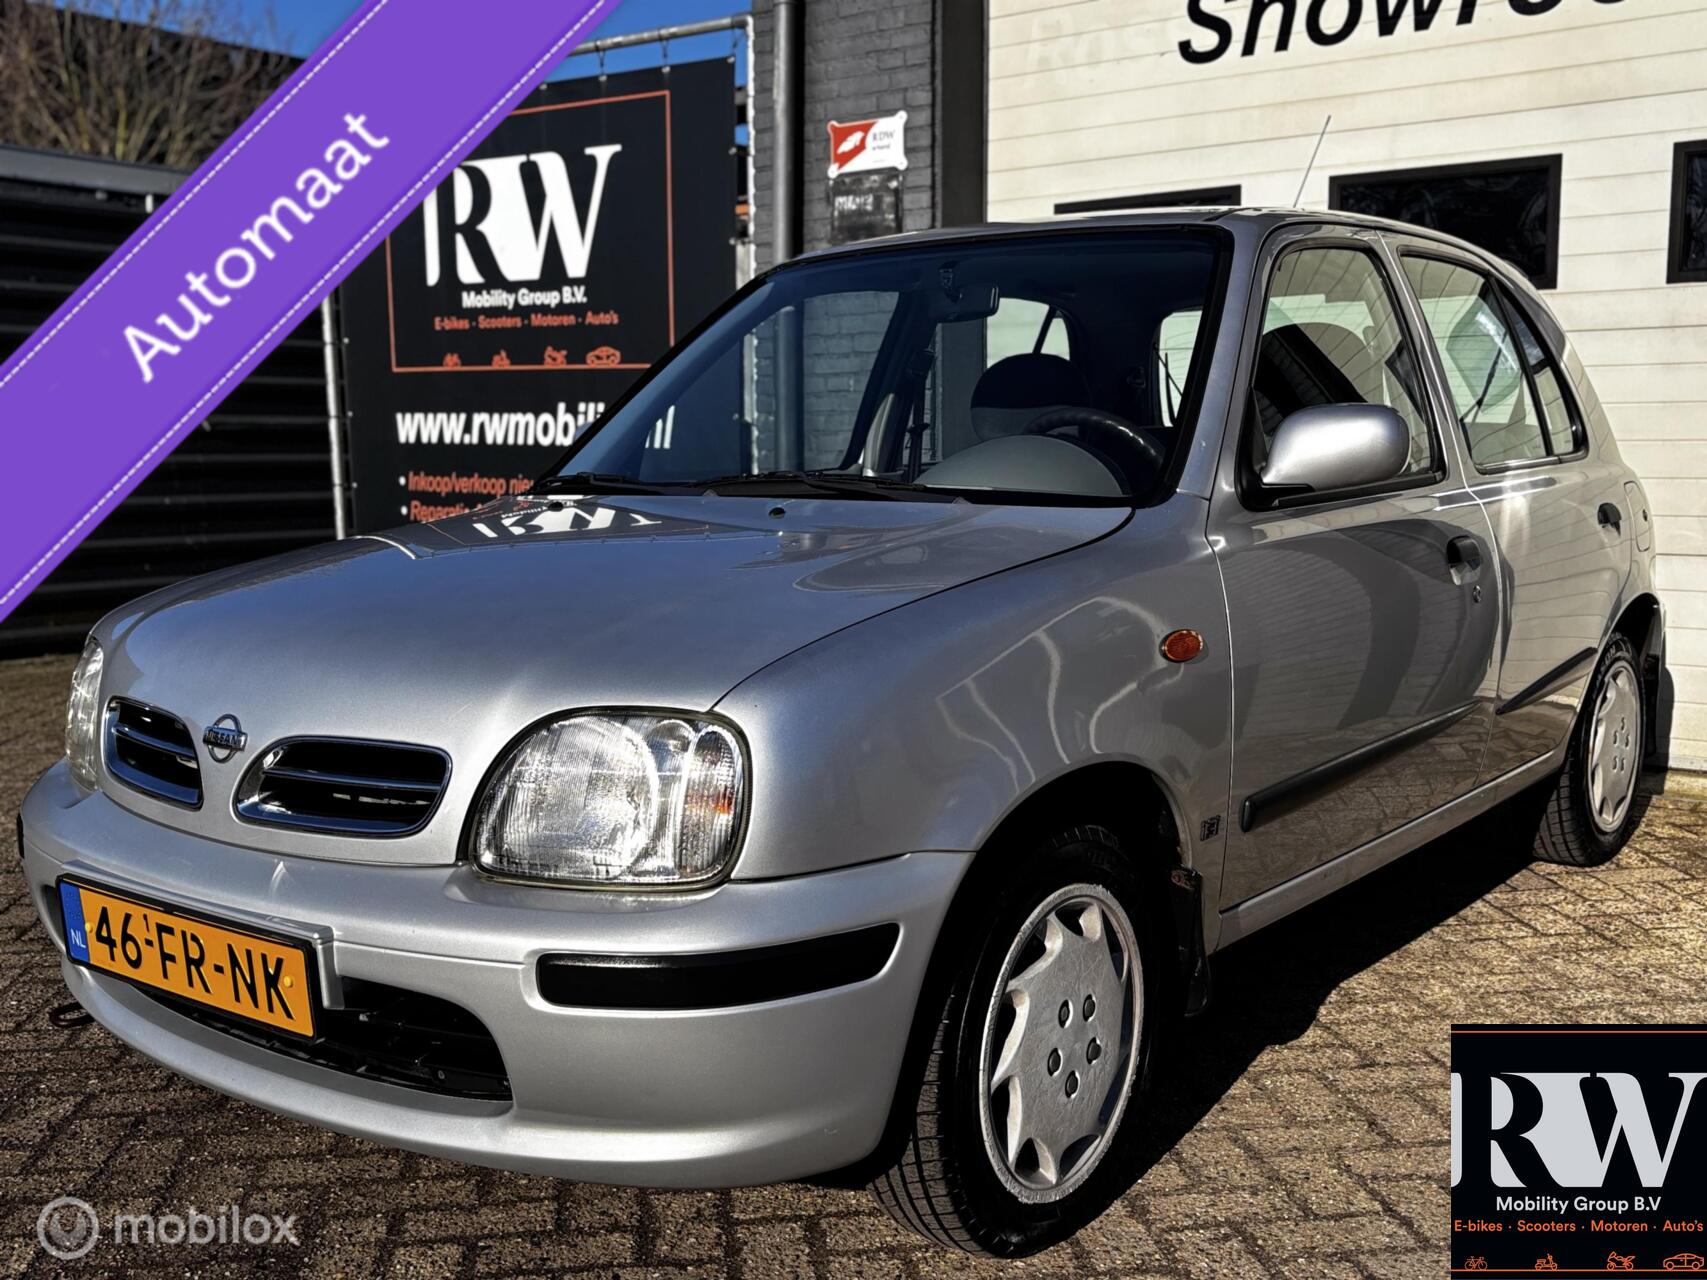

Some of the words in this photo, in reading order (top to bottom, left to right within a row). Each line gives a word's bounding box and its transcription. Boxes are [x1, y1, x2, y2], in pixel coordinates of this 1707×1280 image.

[423, 143, 623, 287] RW
[461, 288, 516, 310] Mobility
[517, 287, 561, 308] Group
[561, 285, 588, 304] B.V.
[434, 316, 470, 331] E-bikes
[478, 314, 523, 329] Scooters
[530, 312, 577, 327] Motoren
[585, 310, 620, 325] Auto's
[407, 471, 507, 498] Inkoop/verkoop
[508, 473, 534, 495] nie
[204, 729, 242, 748] NISSAN
[70, 928, 86, 949] NL
